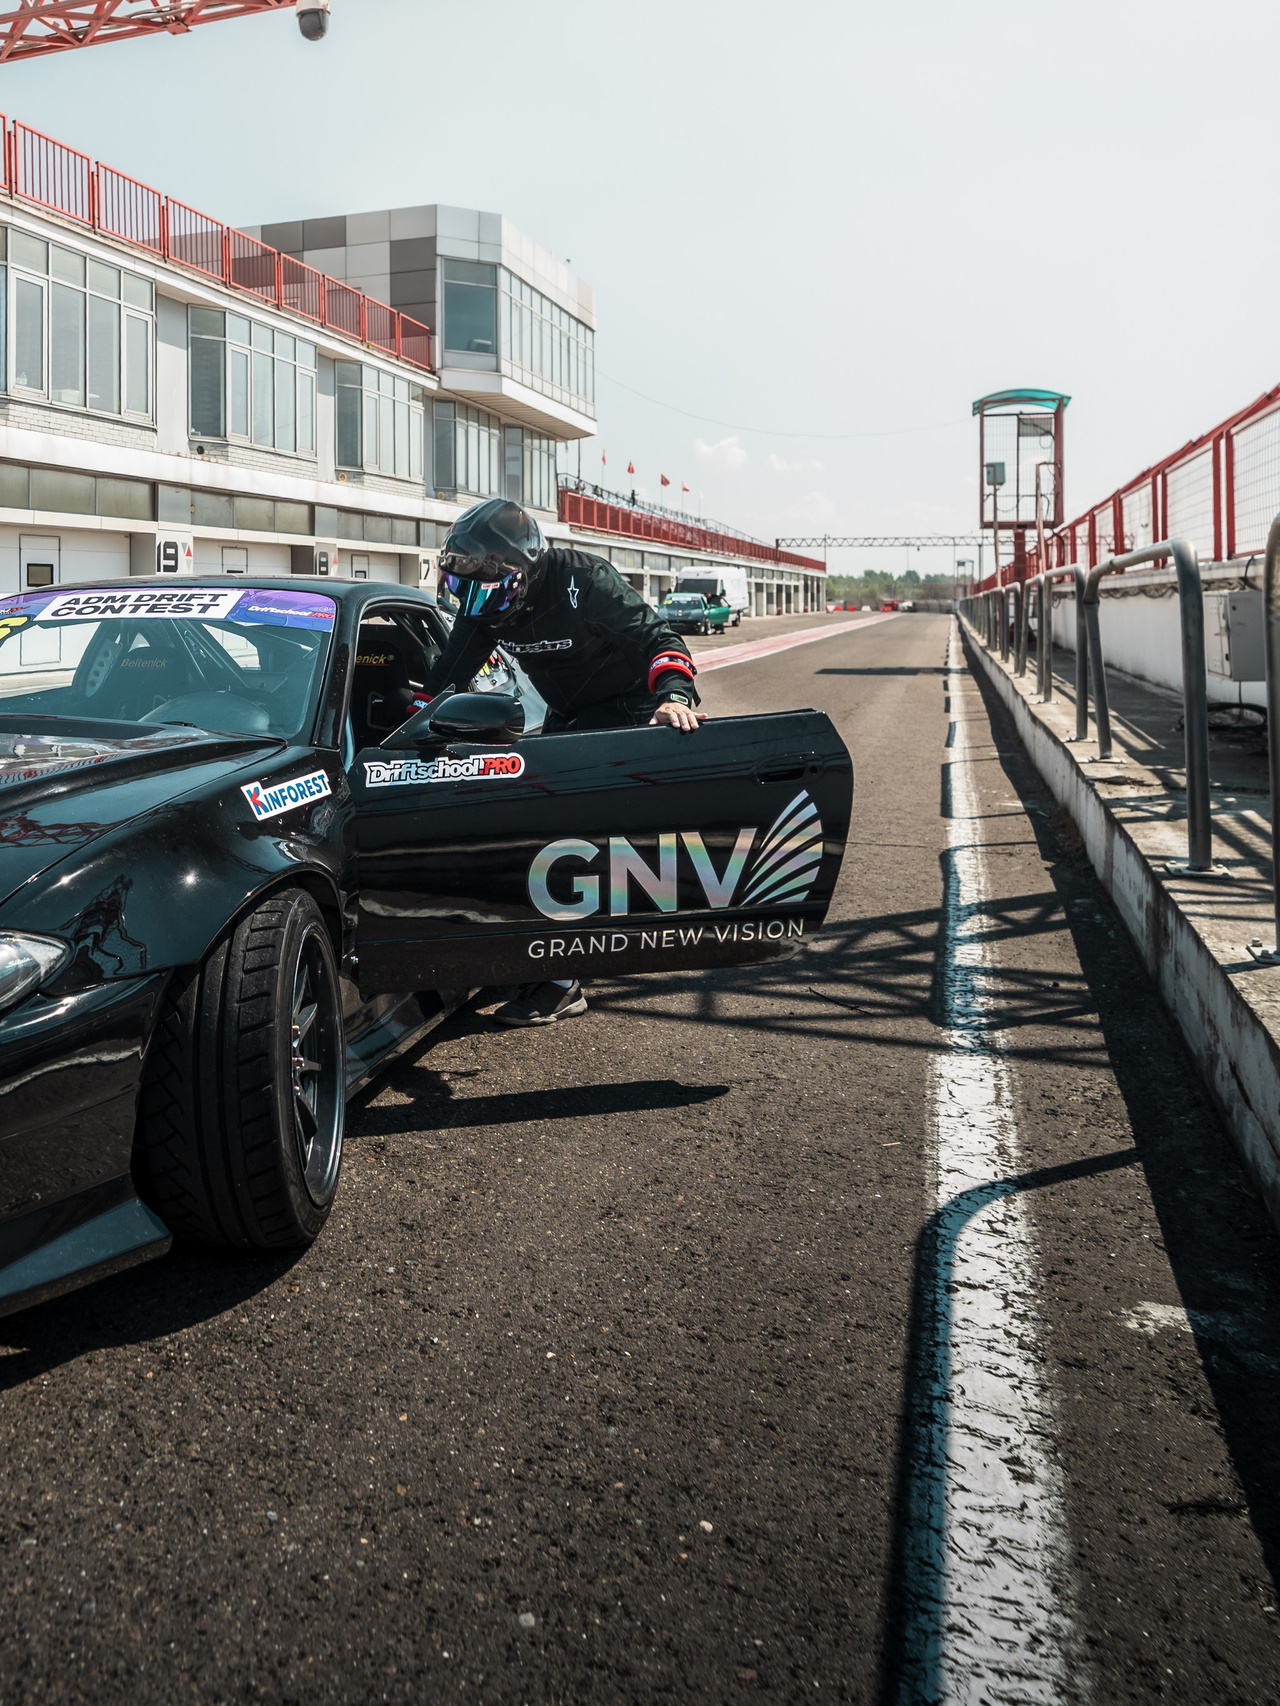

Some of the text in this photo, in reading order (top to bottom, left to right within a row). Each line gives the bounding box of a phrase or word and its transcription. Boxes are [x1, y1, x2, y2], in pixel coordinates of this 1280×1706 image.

[156, 541, 179, 573] 19
[51, 603, 220, 617] CONTEST
[60, 593, 228, 607] ADM DRIFT
[369, 756, 522, 783] Driftschool.PRO
[527, 827, 758, 922] GNV
[527, 918, 805, 959] GRAND NEW VISION
